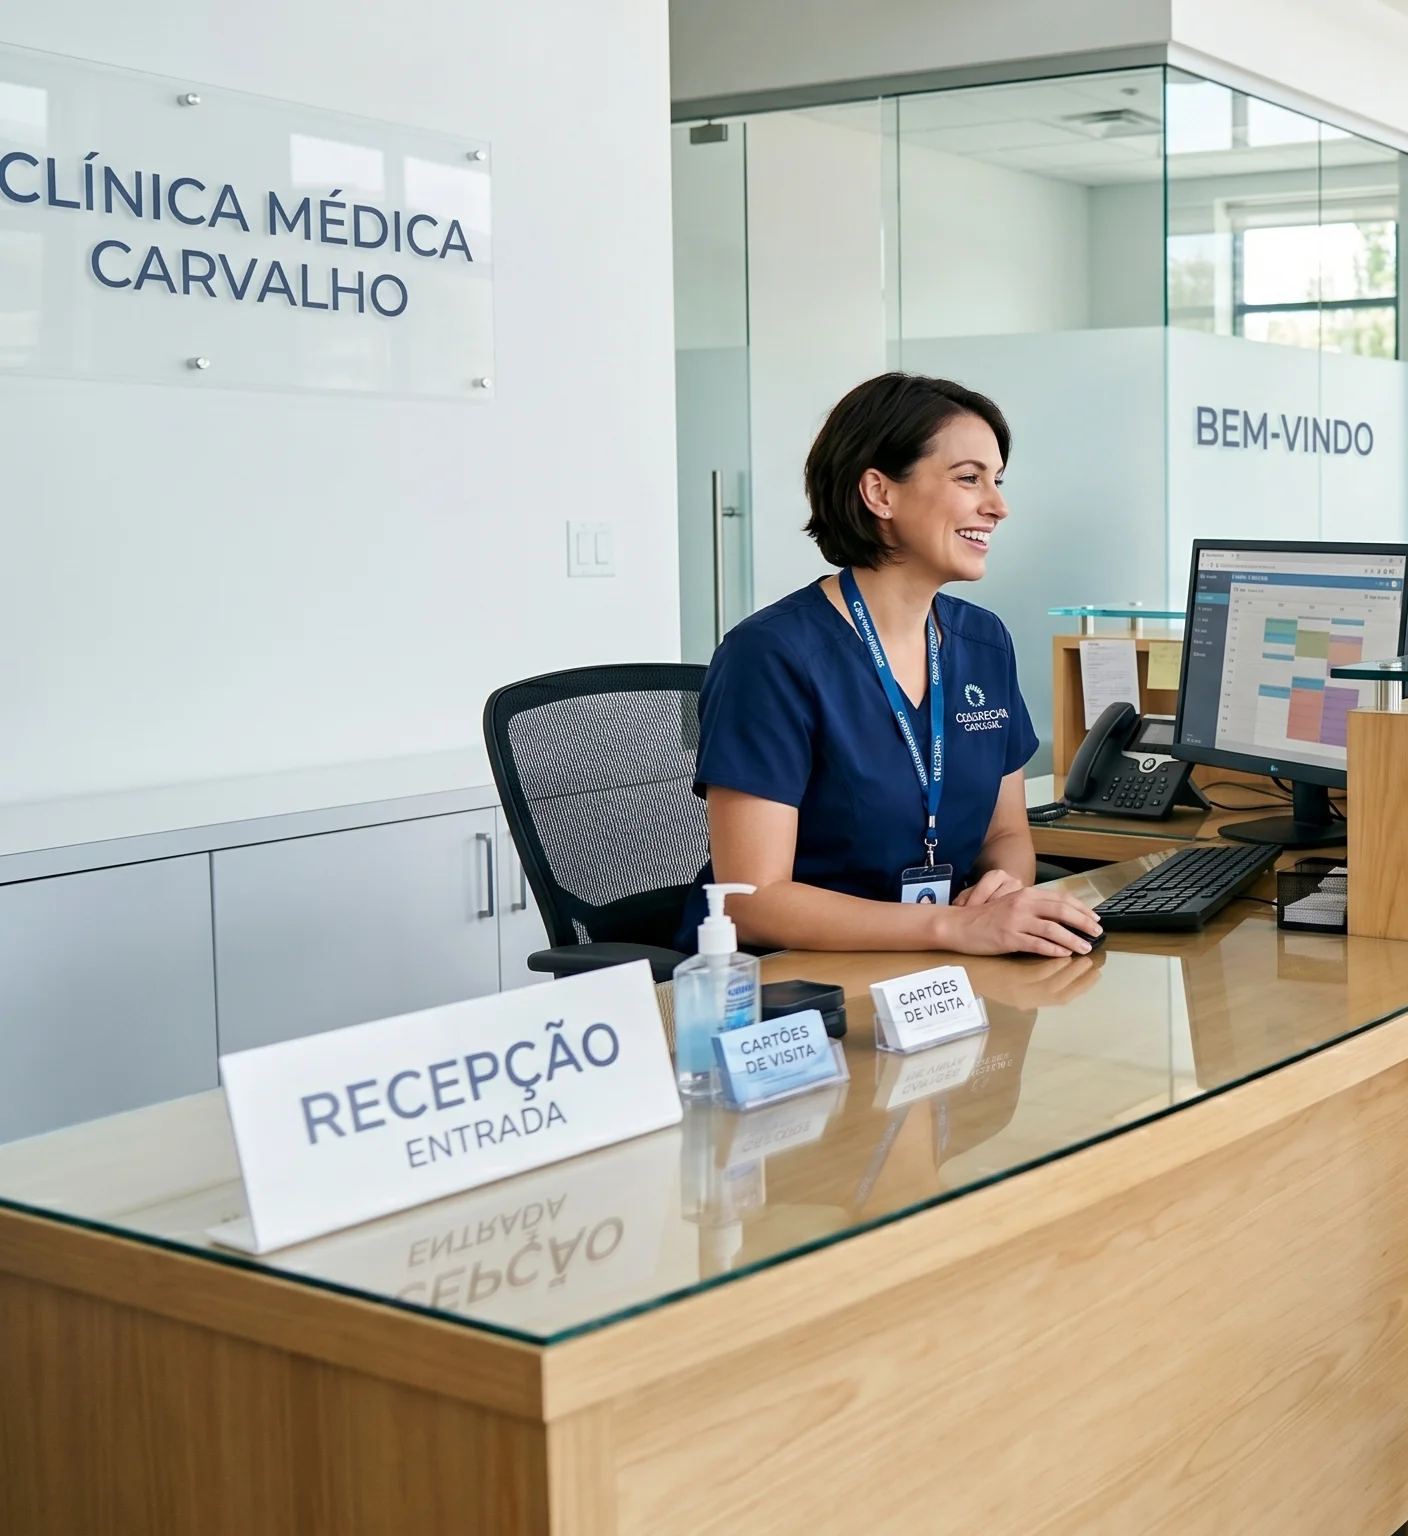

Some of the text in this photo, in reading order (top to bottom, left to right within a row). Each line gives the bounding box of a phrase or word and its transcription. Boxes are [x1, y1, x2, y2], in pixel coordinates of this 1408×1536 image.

[0, 151, 473, 262] CLÍNICA MÉDICA
[91, 239, 408, 318] CARVALHO
[1196, 405, 1375, 456] BEM-VINDO
[899, 979, 958, 1005] CARTÕES
[904, 996, 965, 1023] DE VISITA
[740, 1025, 809, 1055] CARTÕES
[745, 1043, 817, 1075] DE VISITA
[300, 1018, 620, 1145] RECEPÇÃO
[405, 1100, 567, 1169] ENTRADA
